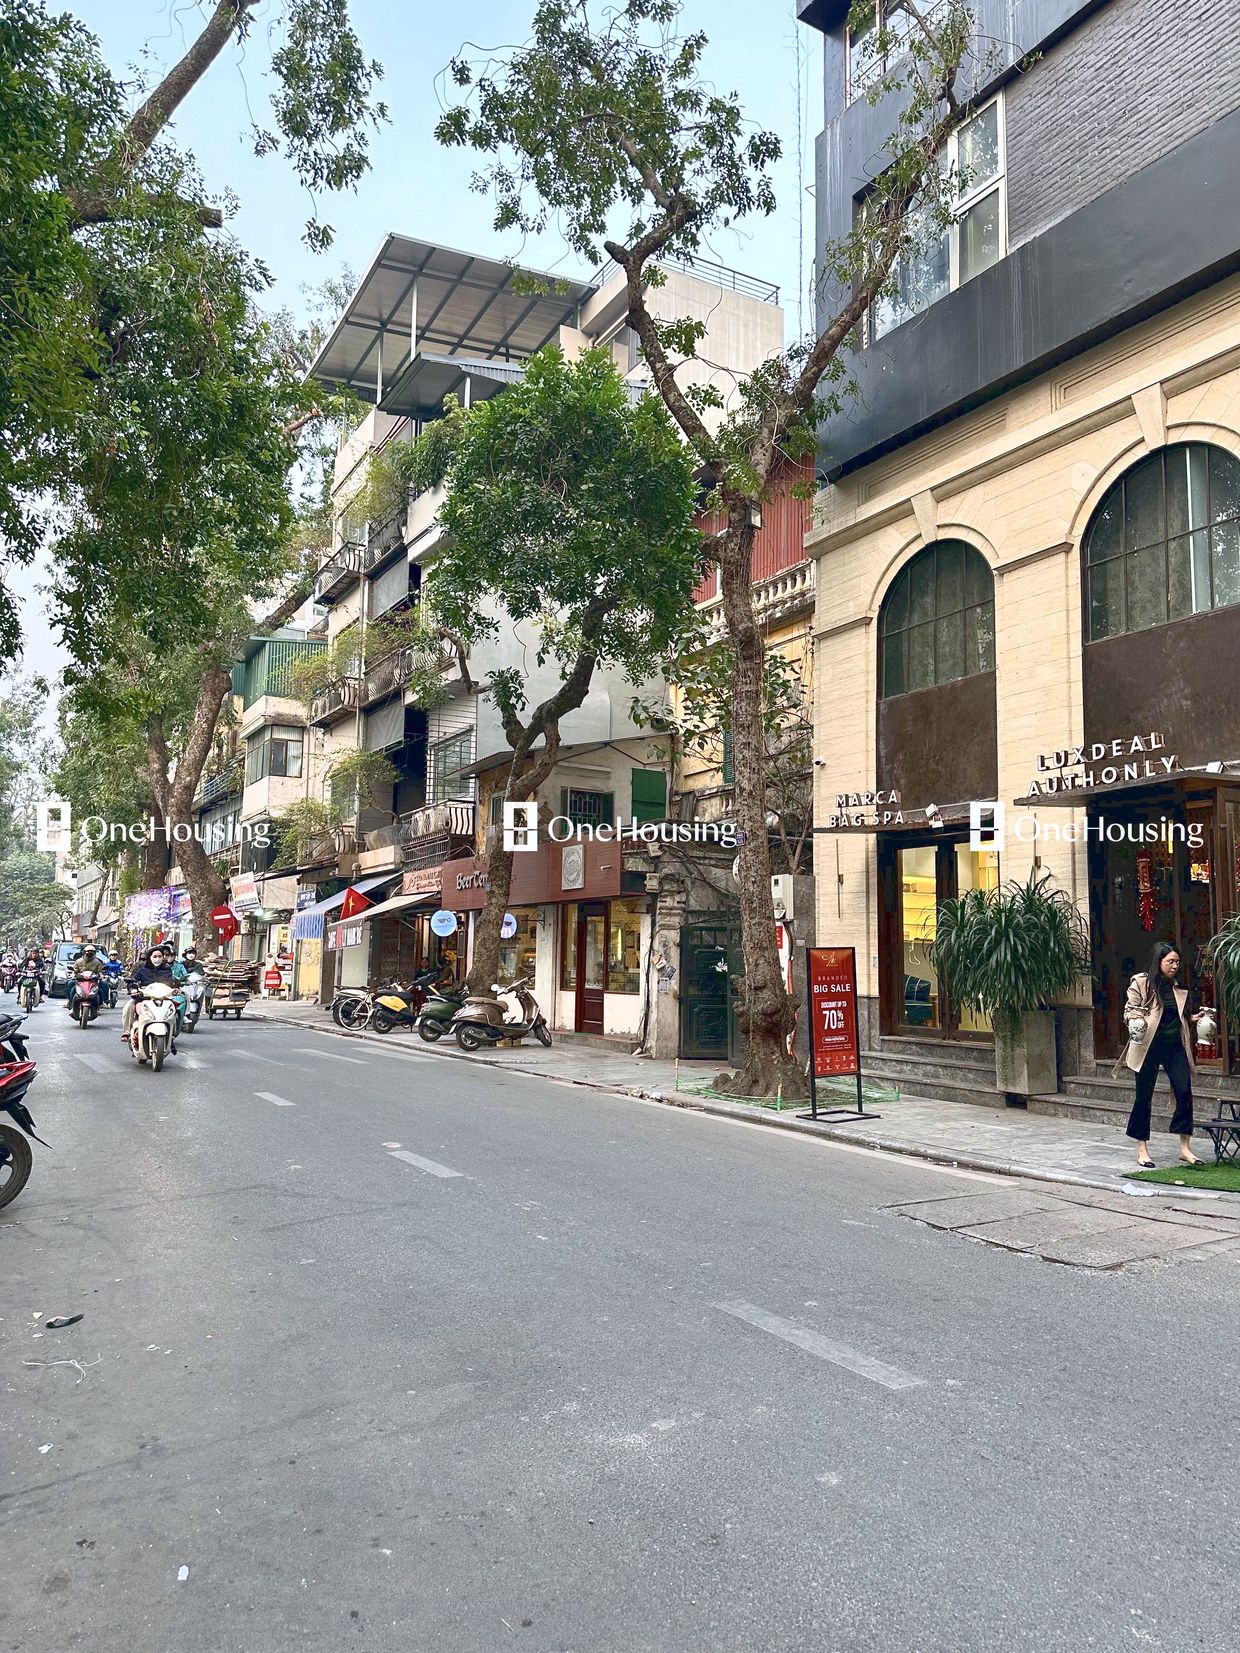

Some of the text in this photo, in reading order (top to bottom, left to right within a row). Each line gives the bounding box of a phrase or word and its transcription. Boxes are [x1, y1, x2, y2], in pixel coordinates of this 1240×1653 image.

[1037, 731, 1164, 772] LUXDEAL
[1028, 755, 1177, 798] AUTHONLY
[836, 790, 899, 807] MARCA
[829, 810, 904, 828] BAG SPA
[456, 872, 473, 890] Beer
[813, 983, 851, 993] BIG SALE
[820, 1001, 836, 1009] DISCOUNT
[837, 1021, 845, 1029] OFF
